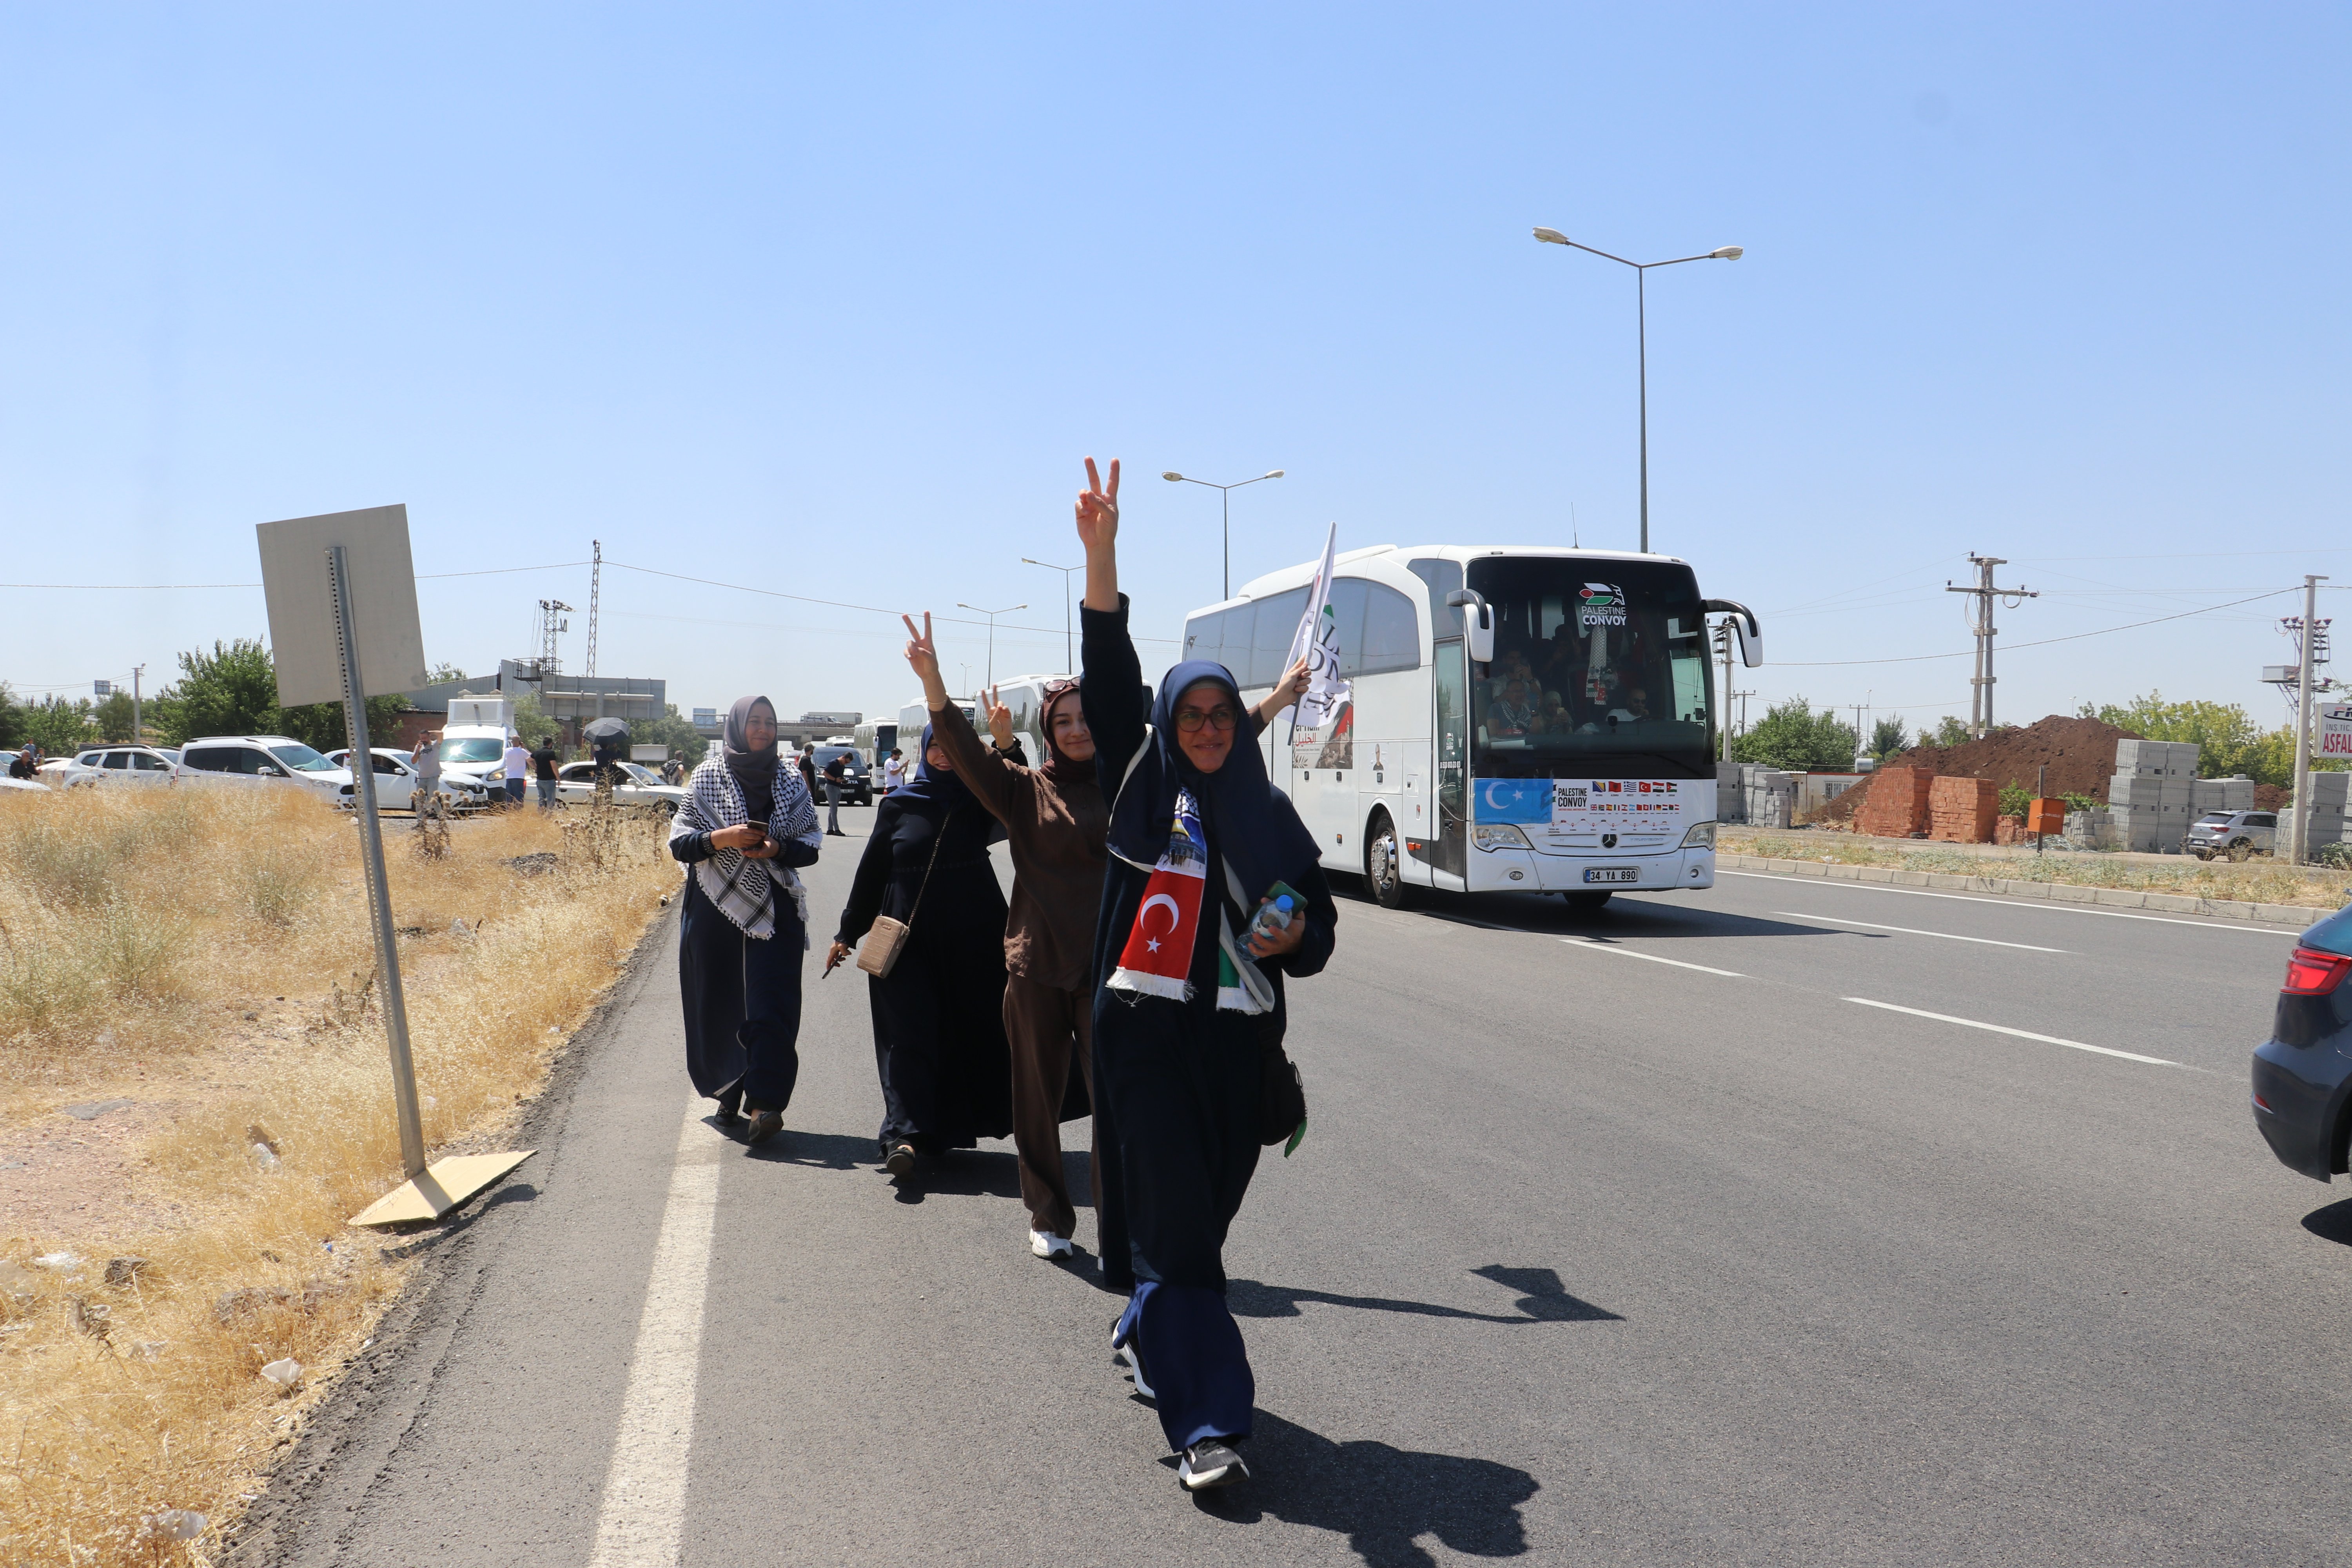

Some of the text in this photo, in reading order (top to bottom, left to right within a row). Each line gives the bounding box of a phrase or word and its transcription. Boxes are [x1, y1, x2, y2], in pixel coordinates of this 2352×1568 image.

[1581, 606, 1626, 615] PALESTINE
[1583, 615, 1626, 626] CONVOY
[1558, 788, 1587, 796] PALESTINE
[1558, 797, 1587, 807] CONVOY
[1590, 871, 1635, 880] 34 YA 890
